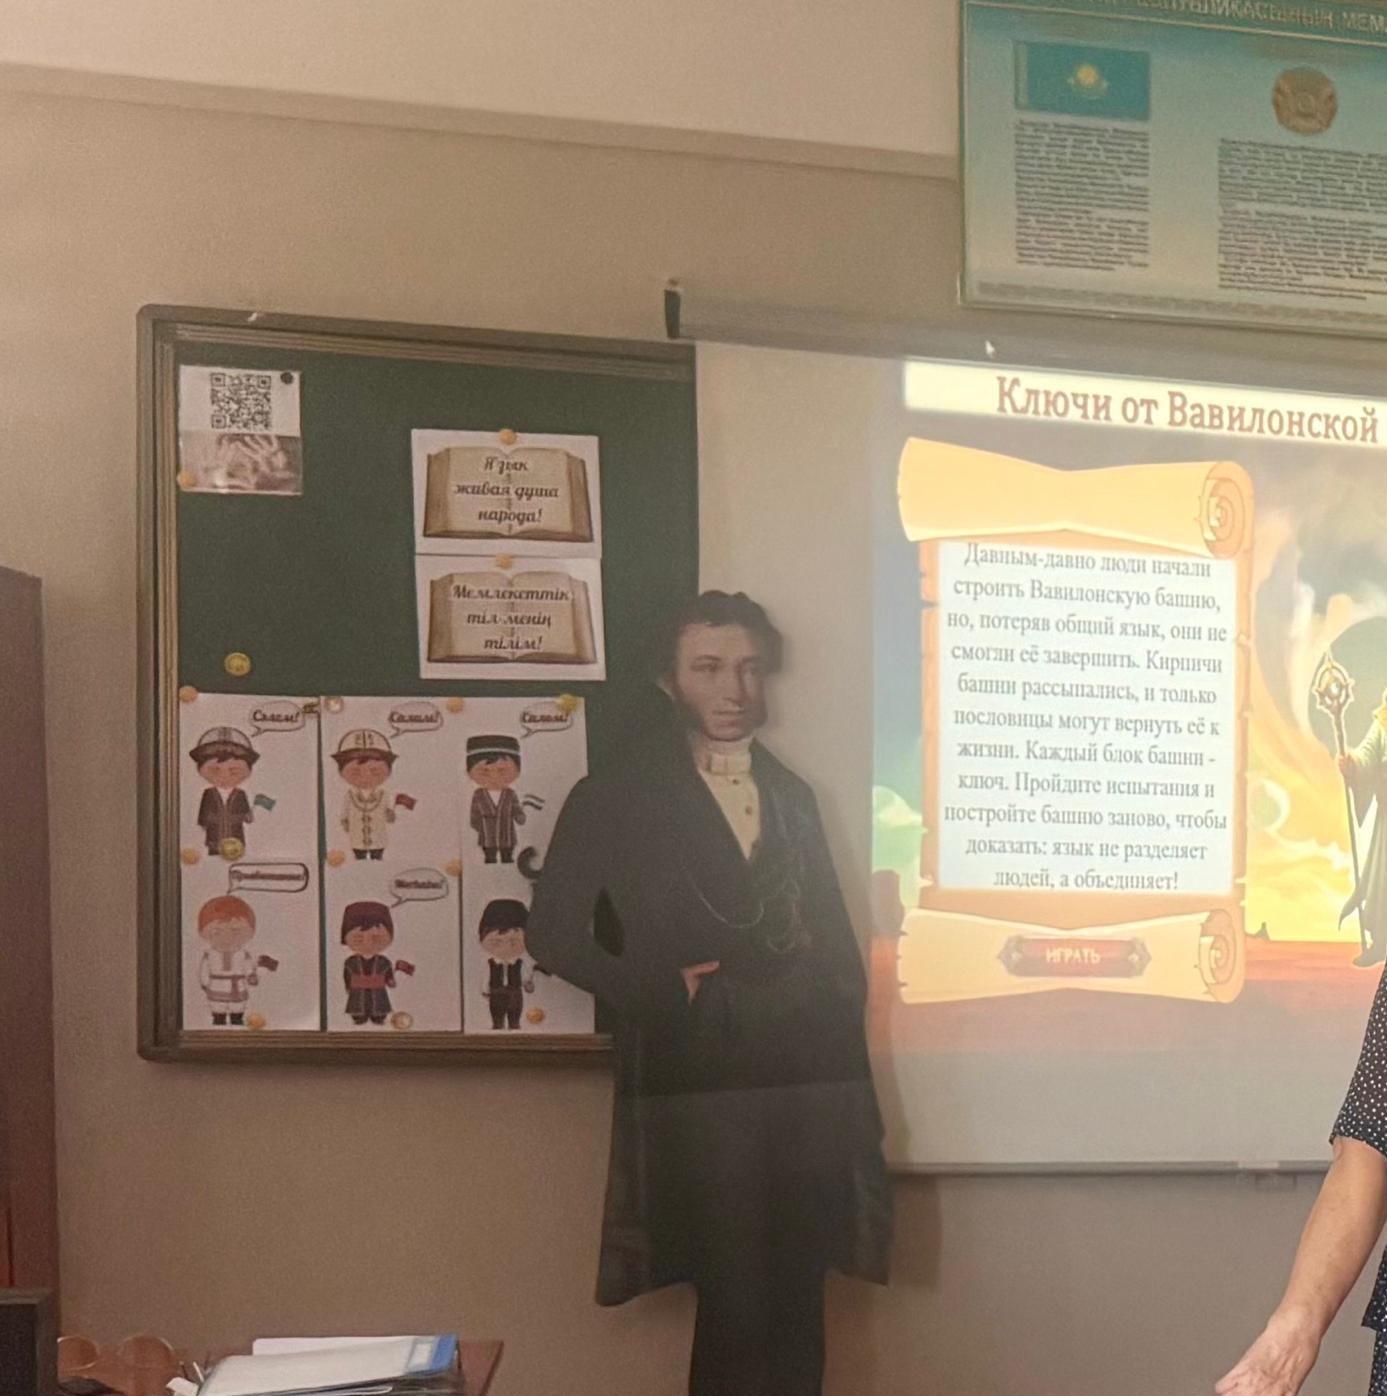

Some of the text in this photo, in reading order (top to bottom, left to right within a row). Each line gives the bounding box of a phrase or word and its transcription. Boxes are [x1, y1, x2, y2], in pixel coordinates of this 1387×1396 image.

[996, 375, 1113, 422] Ключи
[1121, 392, 1157, 425] от
[1168, 390, 1379, 443] Вавилонской
[484, 456, 528, 475] Язык
[453, 483, 559, 502] живая душа
[478, 509, 542, 526] народа!
[964, 542, 1211, 577] Давным-давно люди начали
[451, 584, 570, 601] Мемлекеттік
[953, 578, 1221, 612] строить Вавилонскую башню,
[947, 612, 1228, 643] но, потеряв общий язык, они не
[483, 635, 543, 650] тілім!
[951, 645, 1223, 675] смогли её завершить. Кирпичи
[957, 672, 1217, 705] башни рассыпались, и только
[953, 709, 1221, 738] пословицы могут вернуть её к
[957, 742, 1019, 760] жизни.
[1025, 740, 1098, 763] Каждый
[1103, 743, 1143, 763] блок
[1148, 745, 1204, 766] башни
[958, 771, 1215, 798] ключ. Пройдите испытания и
[944, 804, 1227, 830] постройте башню заново, чтобы
[965, 838, 1208, 863] доказать: язык не разделяет
[993, 870, 1179, 891] людей, а объединяет!
[1046, 947, 1101, 964] ИГРАТЬ
